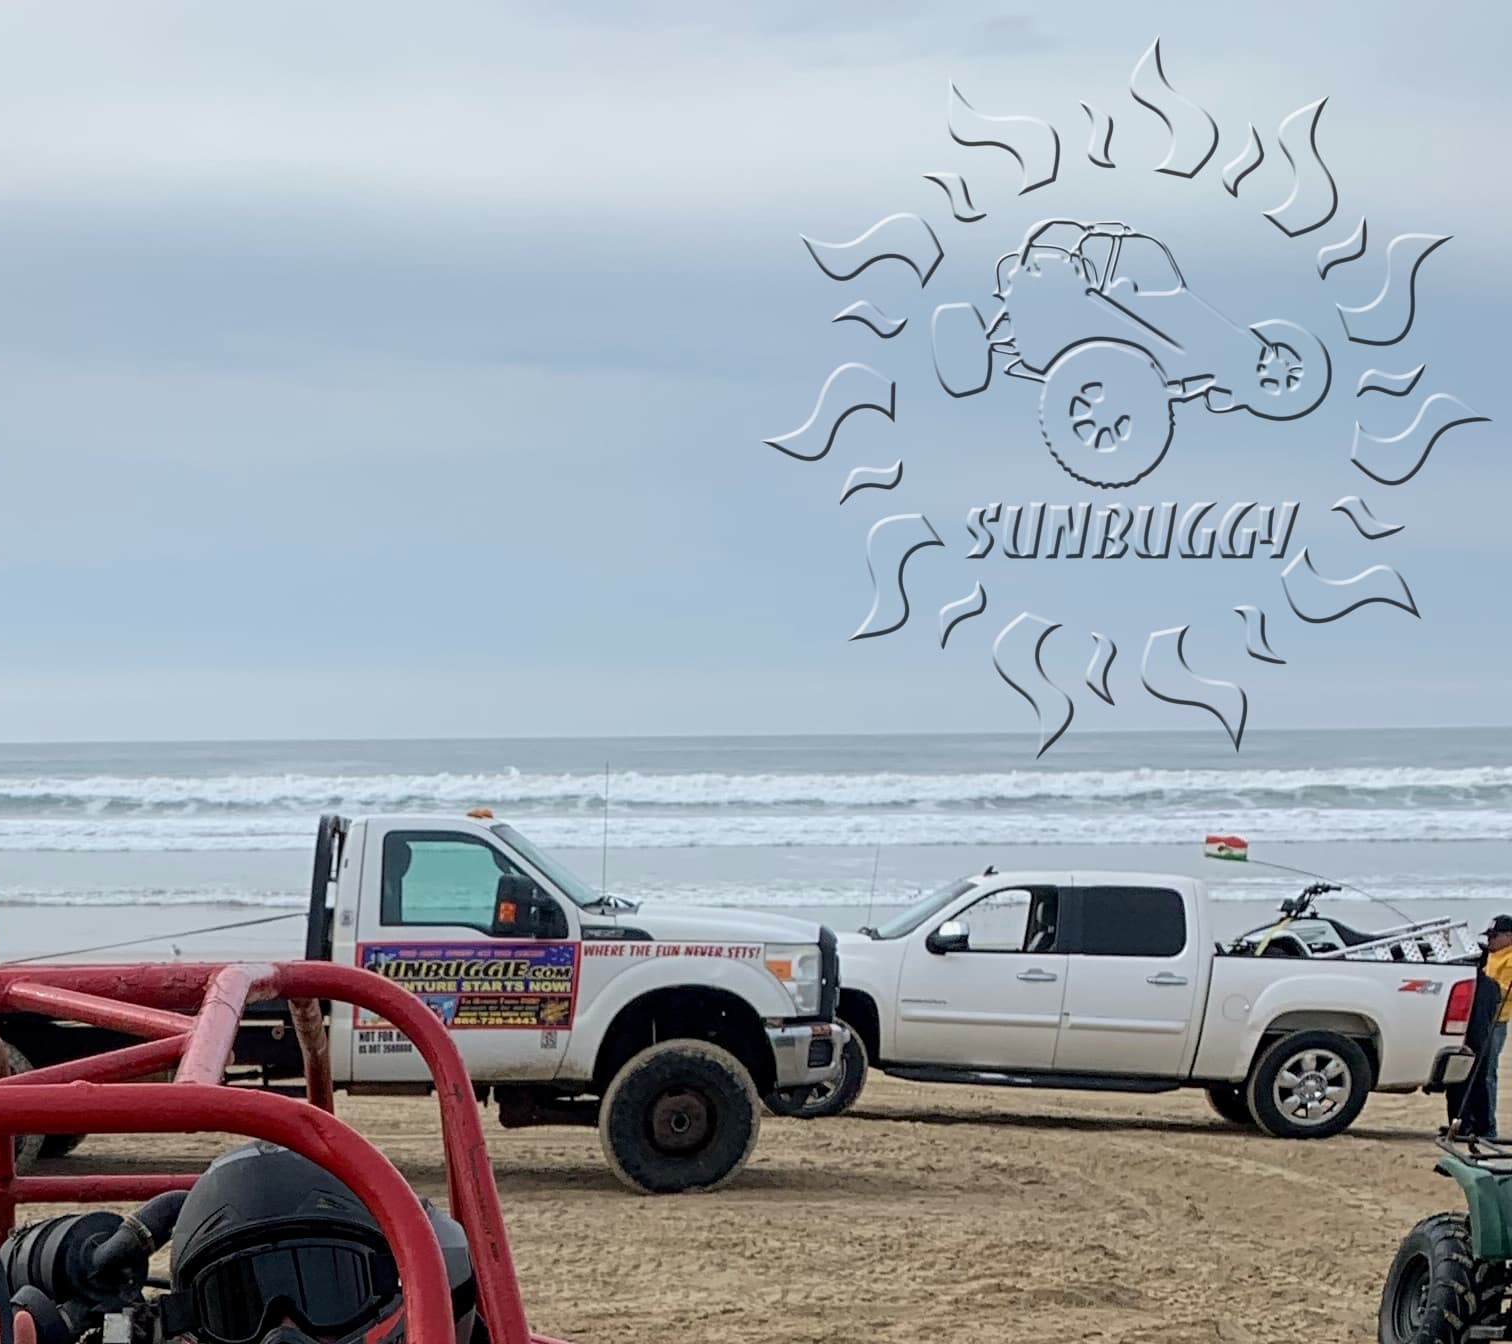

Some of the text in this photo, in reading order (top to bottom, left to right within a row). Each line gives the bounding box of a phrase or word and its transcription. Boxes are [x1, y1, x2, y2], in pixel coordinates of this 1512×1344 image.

[583, 944, 626, 957] WHERE
[630, 944, 651, 957] THE
[655, 944, 680, 957] FUN
[685, 945, 722, 957] NEVER
[358, 1031, 375, 1042] NOT
[378, 1031, 394, 1042] FOR
